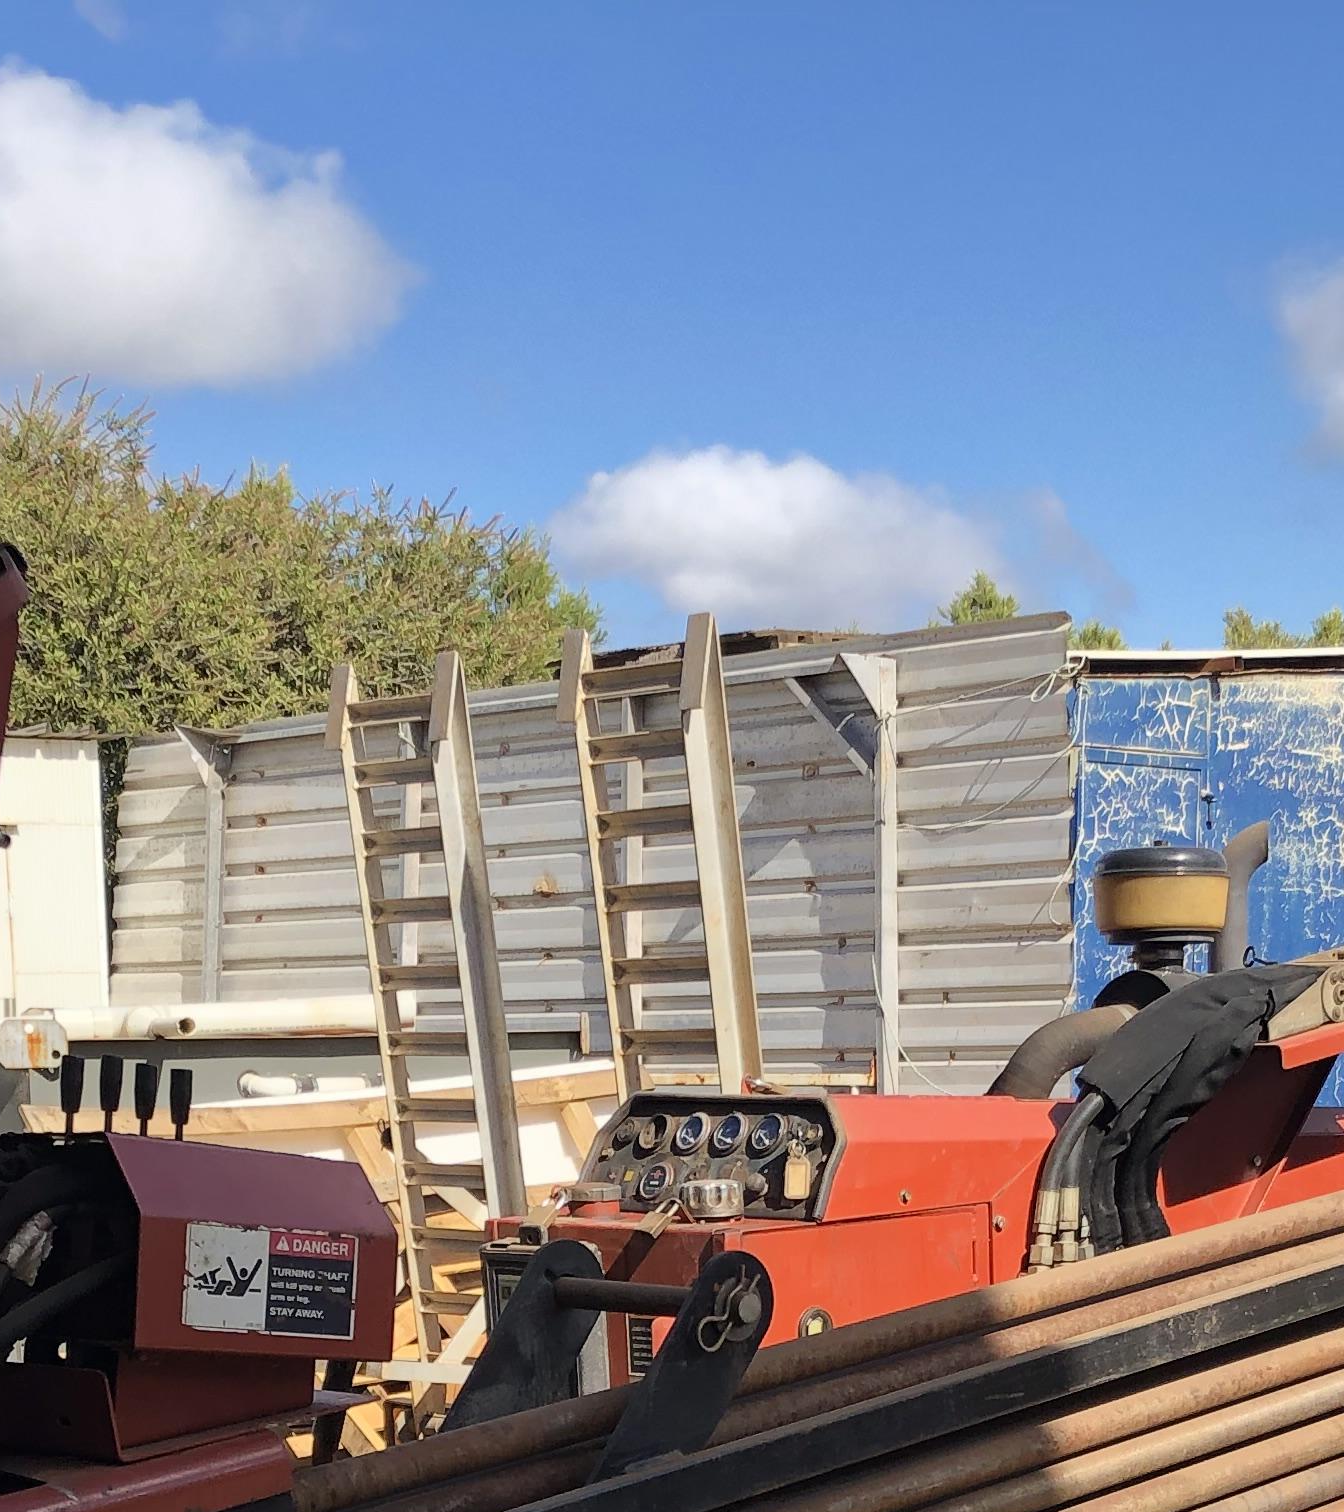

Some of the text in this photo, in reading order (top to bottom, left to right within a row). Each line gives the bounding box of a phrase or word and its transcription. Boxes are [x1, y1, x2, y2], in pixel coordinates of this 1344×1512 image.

[293, 1239, 349, 1256] DANGER
[271, 1267, 316, 1279] TURNING
[269, 1307, 325, 1319] STAY AWAY.
